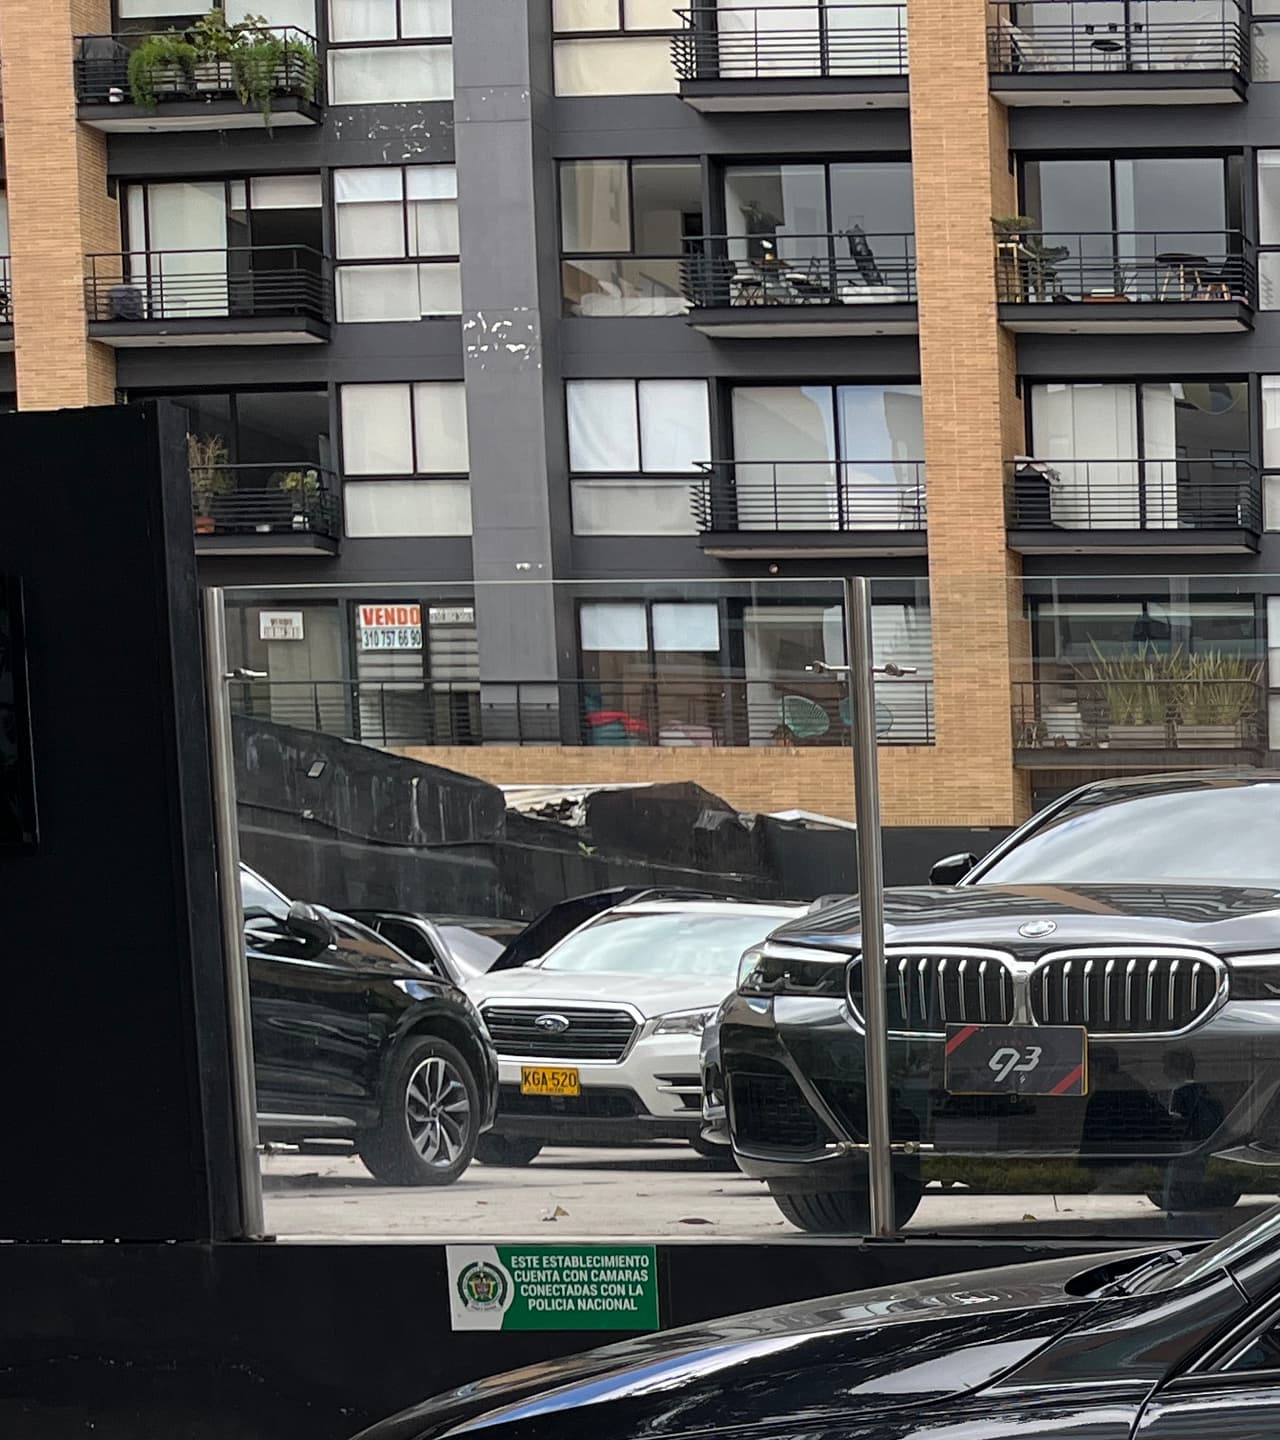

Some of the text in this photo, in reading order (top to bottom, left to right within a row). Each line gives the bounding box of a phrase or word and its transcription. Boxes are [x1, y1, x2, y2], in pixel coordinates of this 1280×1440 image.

[362, 607, 421, 625] VENDO
[364, 631, 379, 647] 310
[381, 631, 396, 646] 757
[989, 1046, 1042, 1082] 93
[511, 1255, 650, 1268] ESTE ESTABLECIMIENTO
[514, 1269, 649, 1282] CUENTA CON CAMARAS
[521, 1284, 644, 1296] CONECTADAS CON LA
[528, 1298, 638, 1311] POLICIA NACIONAL
